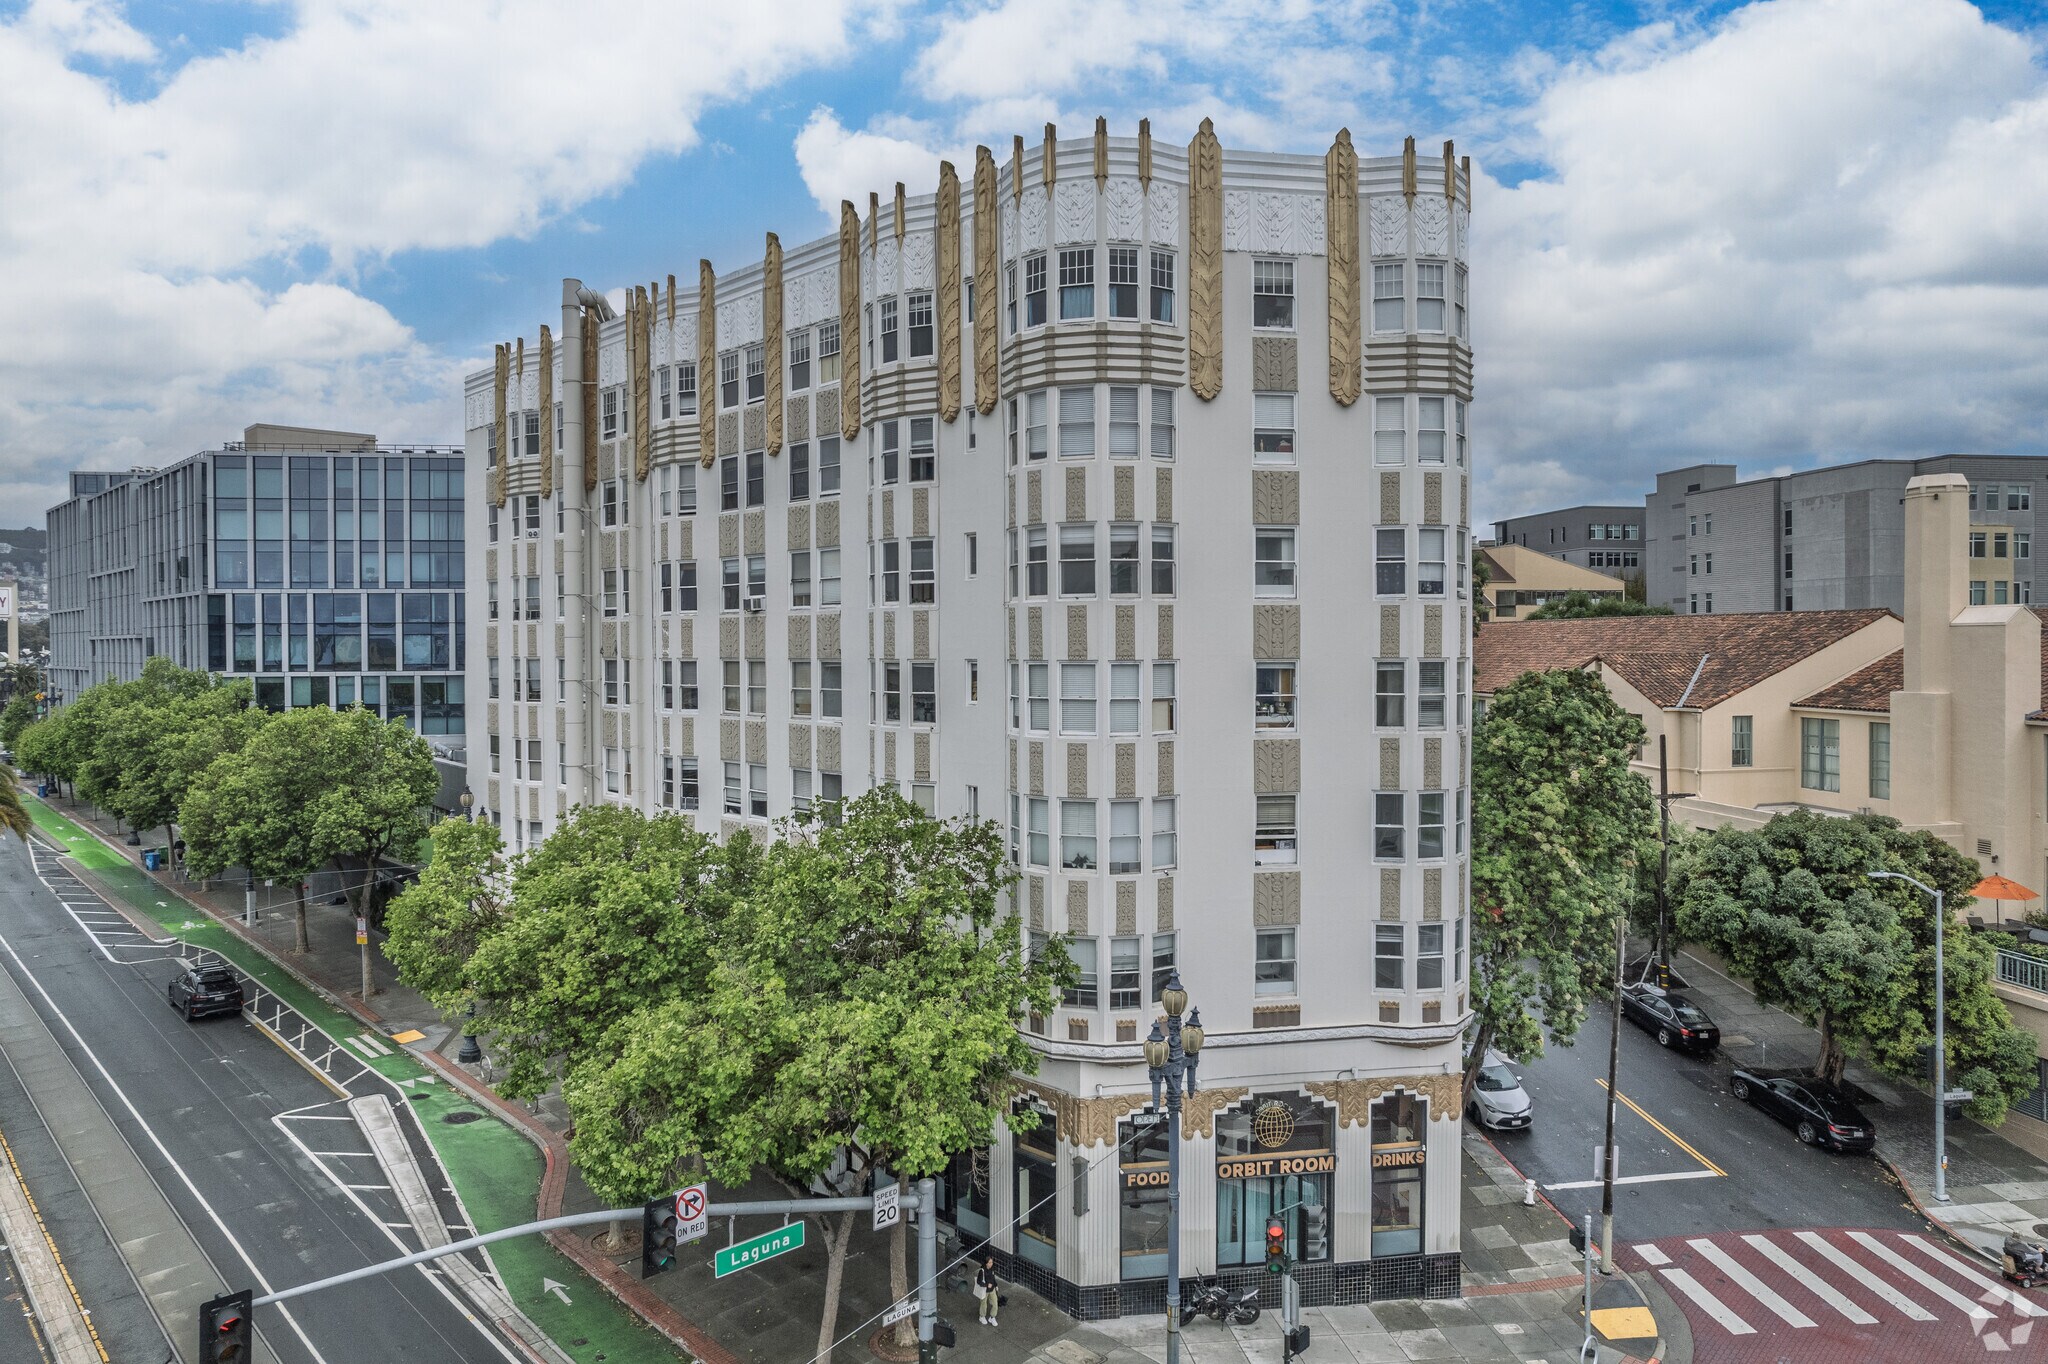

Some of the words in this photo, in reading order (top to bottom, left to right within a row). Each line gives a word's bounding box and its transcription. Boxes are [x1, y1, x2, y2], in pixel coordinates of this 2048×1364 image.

[1218, 1160, 1274, 1179] ORBIT
[1280, 1156, 1334, 1174] ROOM
[1372, 1151, 1425, 1167] DRINKS
[1127, 1171, 1170, 1187] FOOD
[876, 1188, 897, 1201] SPEED
[878, 1197, 895, 1208] LIMIT
[877, 1205, 897, 1224] 20
[677, 1227, 688, 1238] ON
[690, 1221, 705, 1233] RED
[731, 1235, 790, 1266] Laguna
[887, 1305, 916, 1323] LAGUNA
